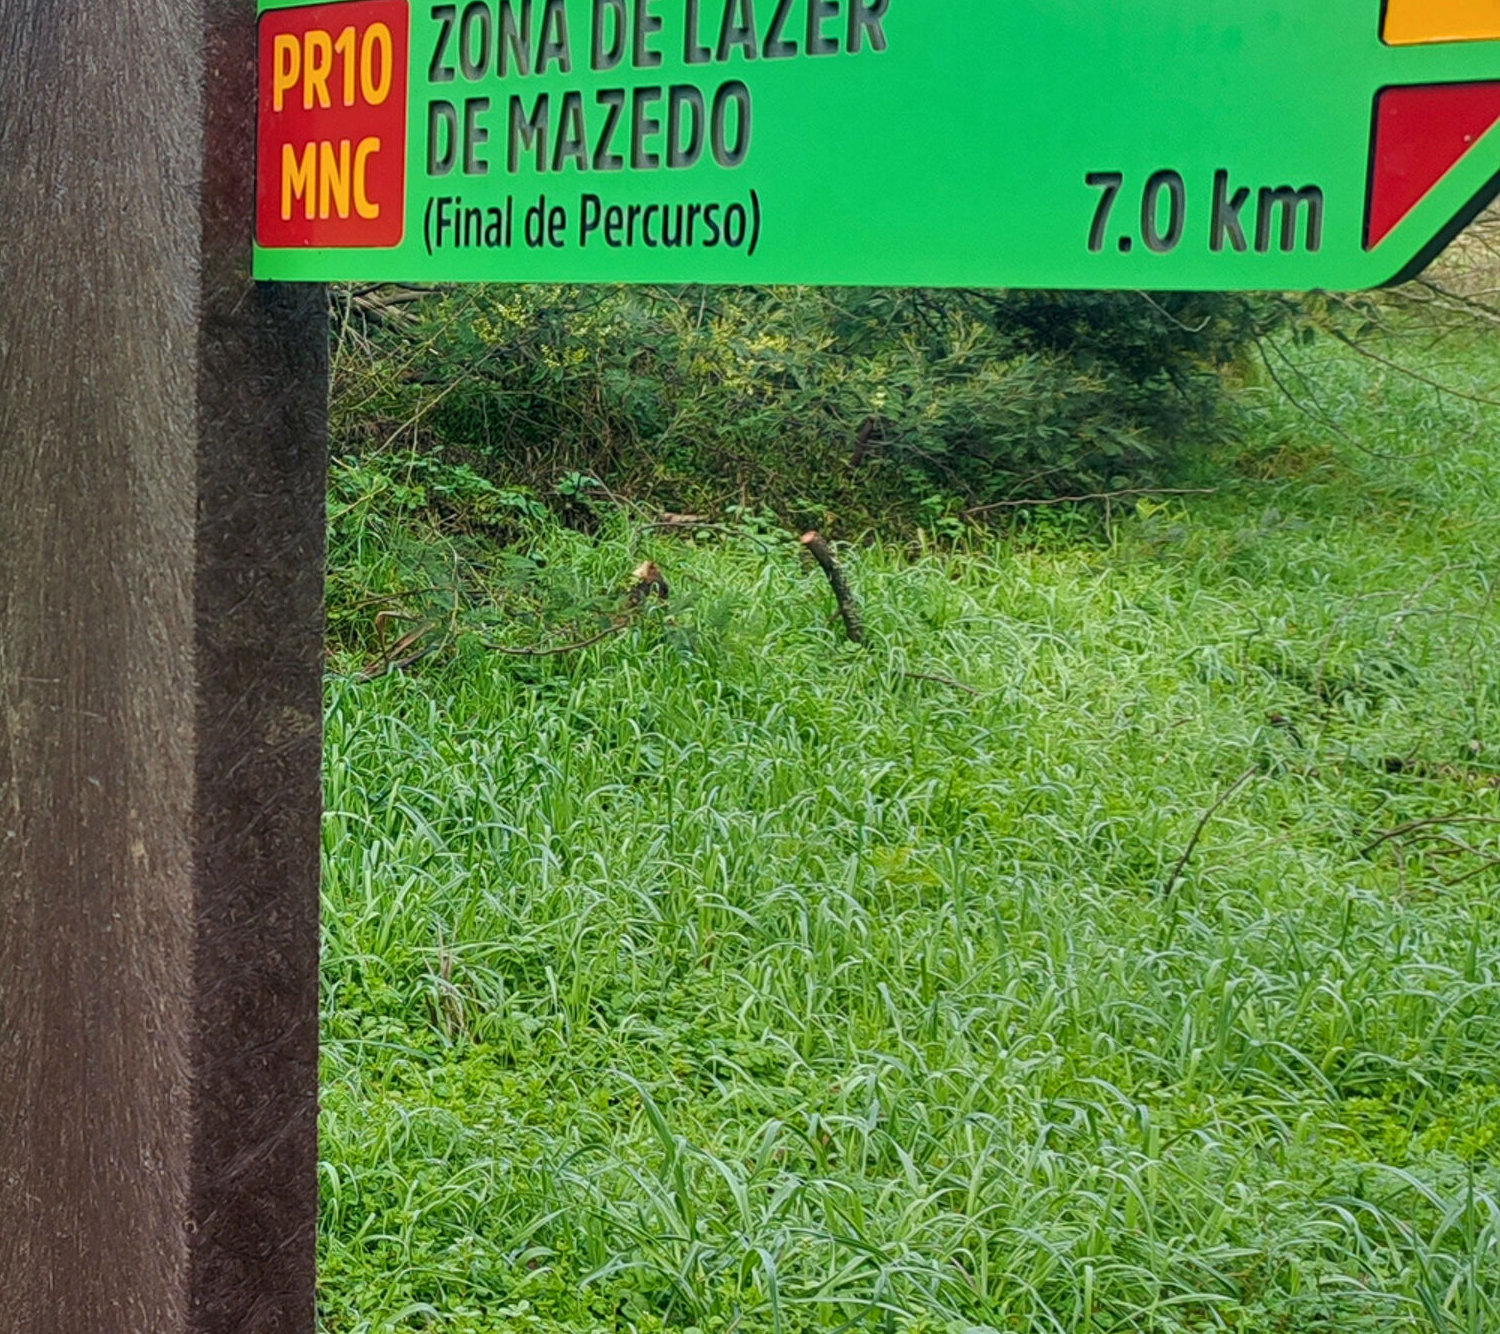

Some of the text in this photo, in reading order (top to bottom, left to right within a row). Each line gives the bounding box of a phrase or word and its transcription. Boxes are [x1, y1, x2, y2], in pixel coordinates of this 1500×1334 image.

[272, 22, 393, 112] PR10
[427, 80, 751, 176] DE MAZEDO
[281, 137, 380, 221] MNC
[1084, 168, 1324, 253] 7.0 km
[424, 189, 761, 257] (Final de Percurso)
